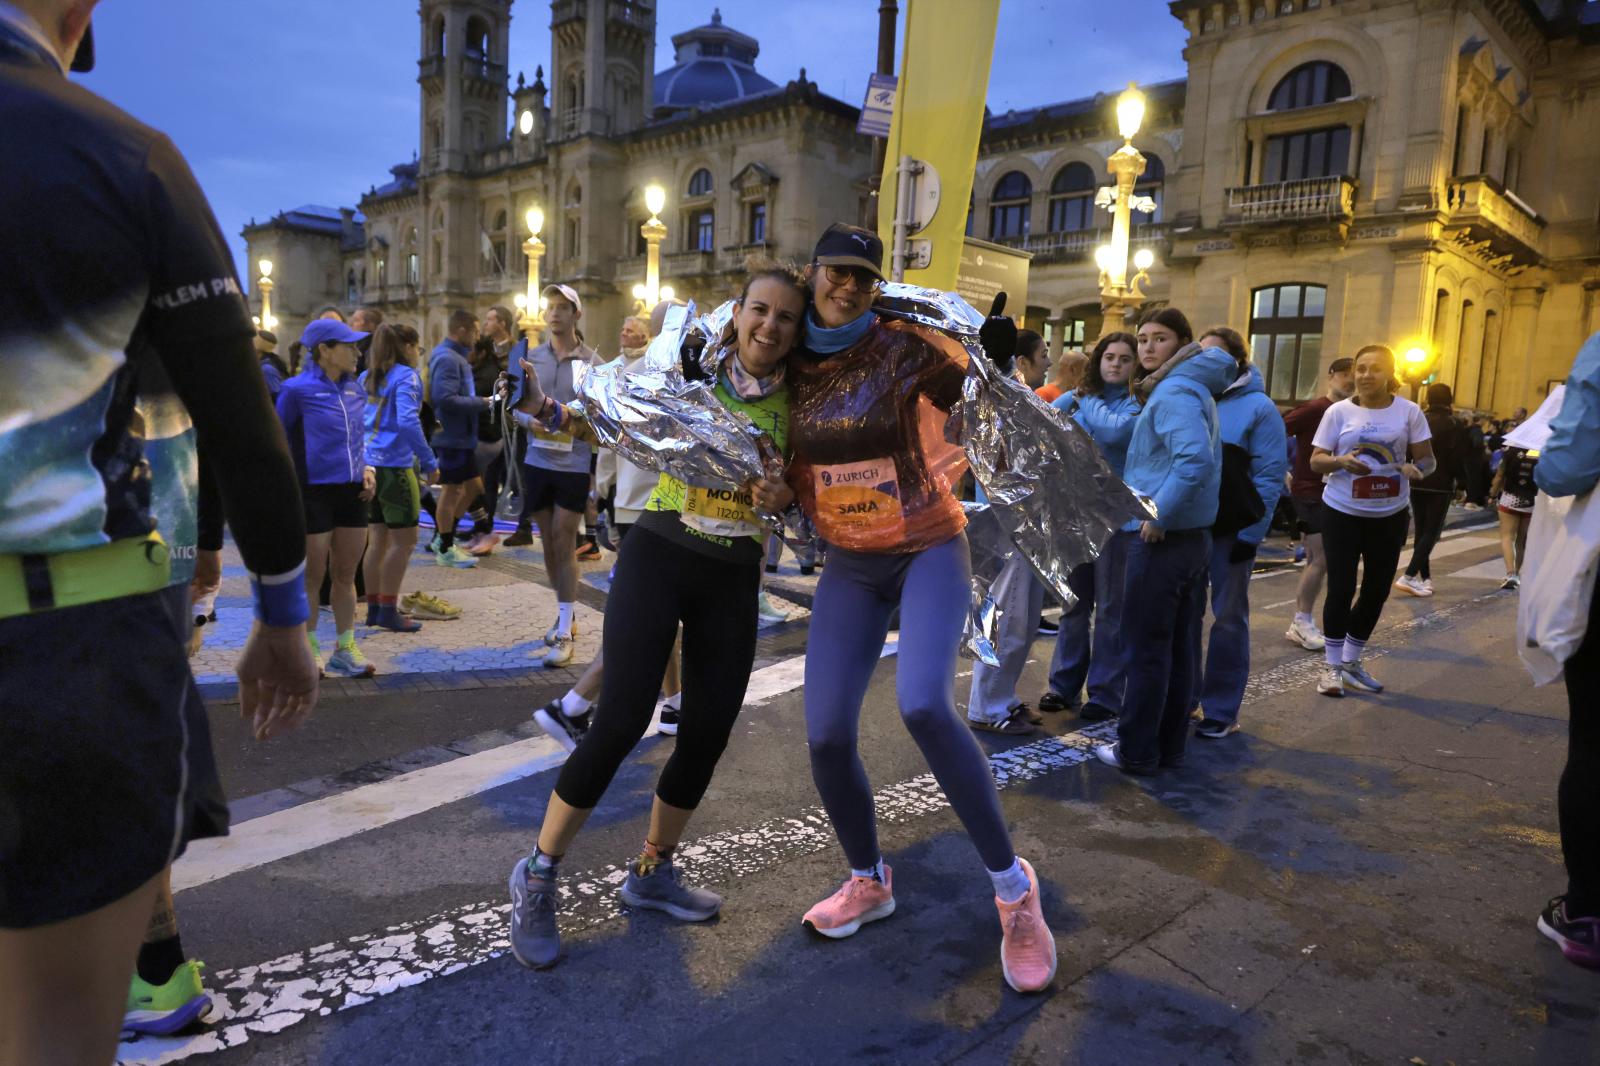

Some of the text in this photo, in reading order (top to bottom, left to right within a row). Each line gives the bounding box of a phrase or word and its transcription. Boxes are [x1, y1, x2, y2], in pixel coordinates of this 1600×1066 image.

[836, 469, 879, 483] ZURICH
[1371, 482, 1390, 491] LISA
[839, 500, 879, 514] SARA
